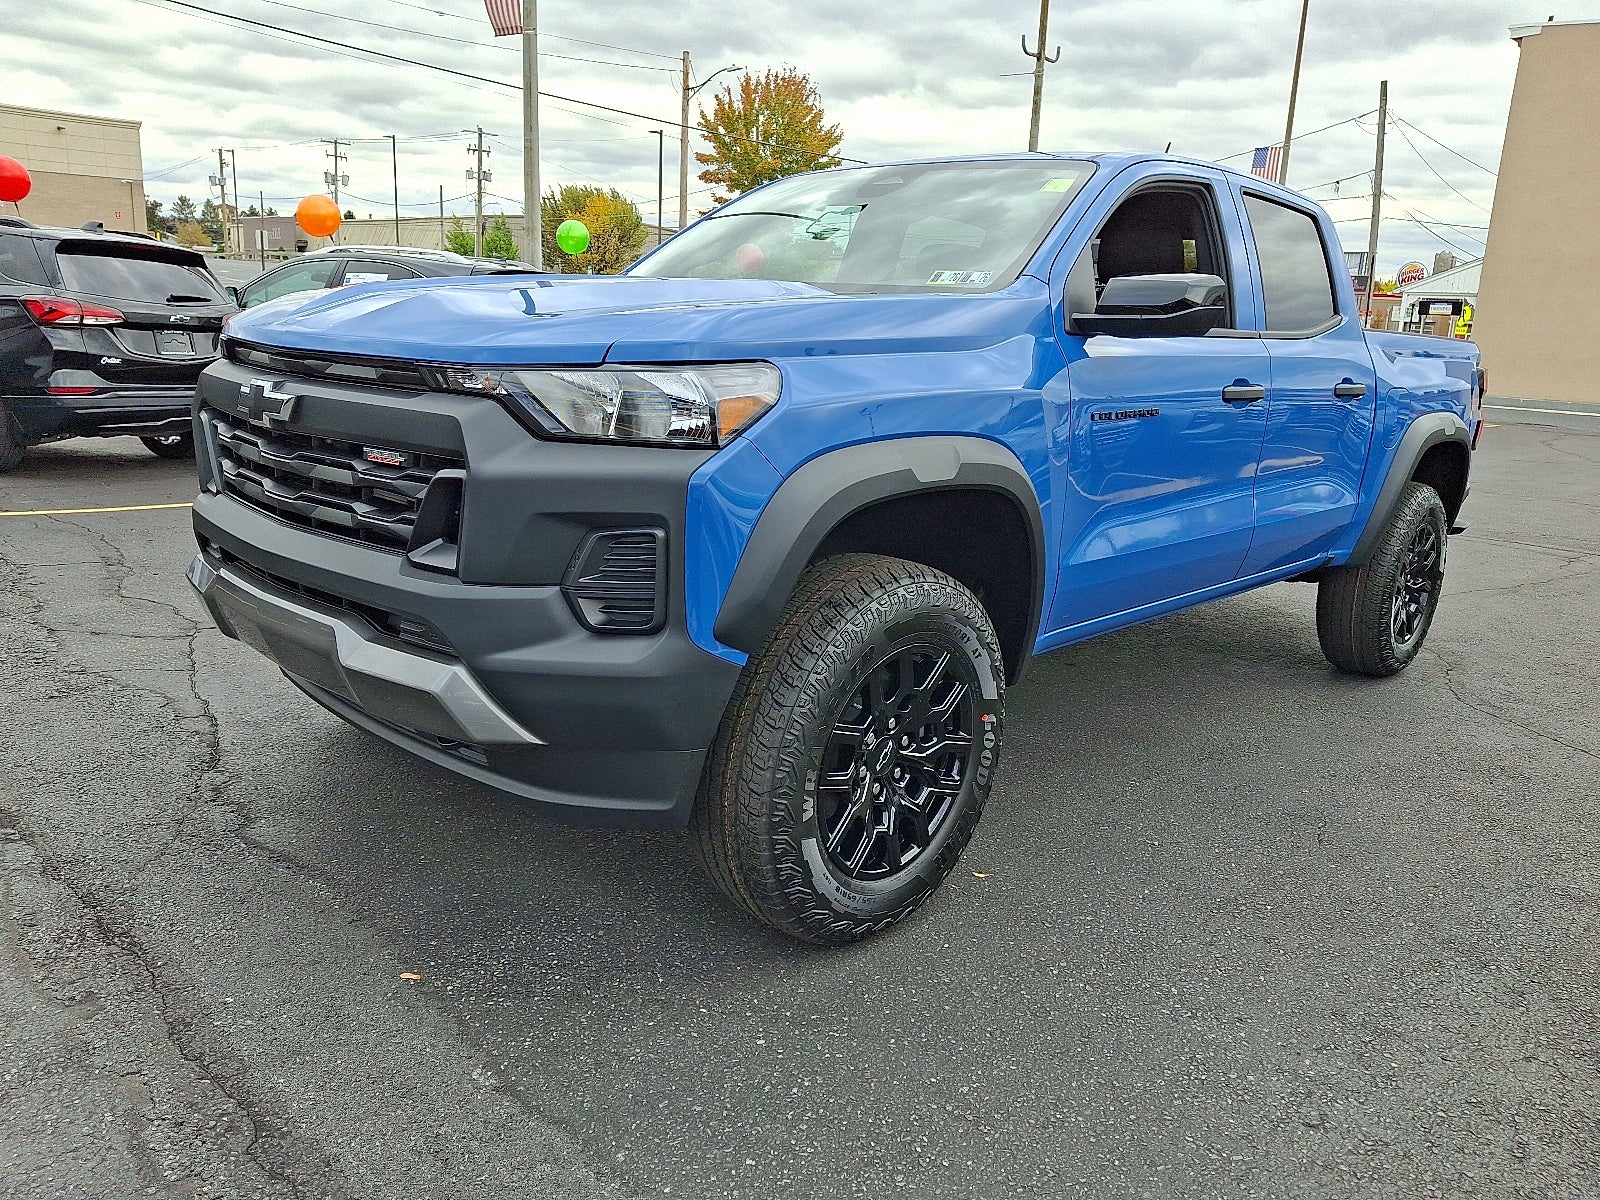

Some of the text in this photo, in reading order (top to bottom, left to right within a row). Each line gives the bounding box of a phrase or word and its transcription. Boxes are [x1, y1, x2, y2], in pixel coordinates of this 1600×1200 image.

[1401, 268, 1425, 278] BURGER
[1401, 273, 1425, 285] KING
[970, 647, 983, 660] AT
